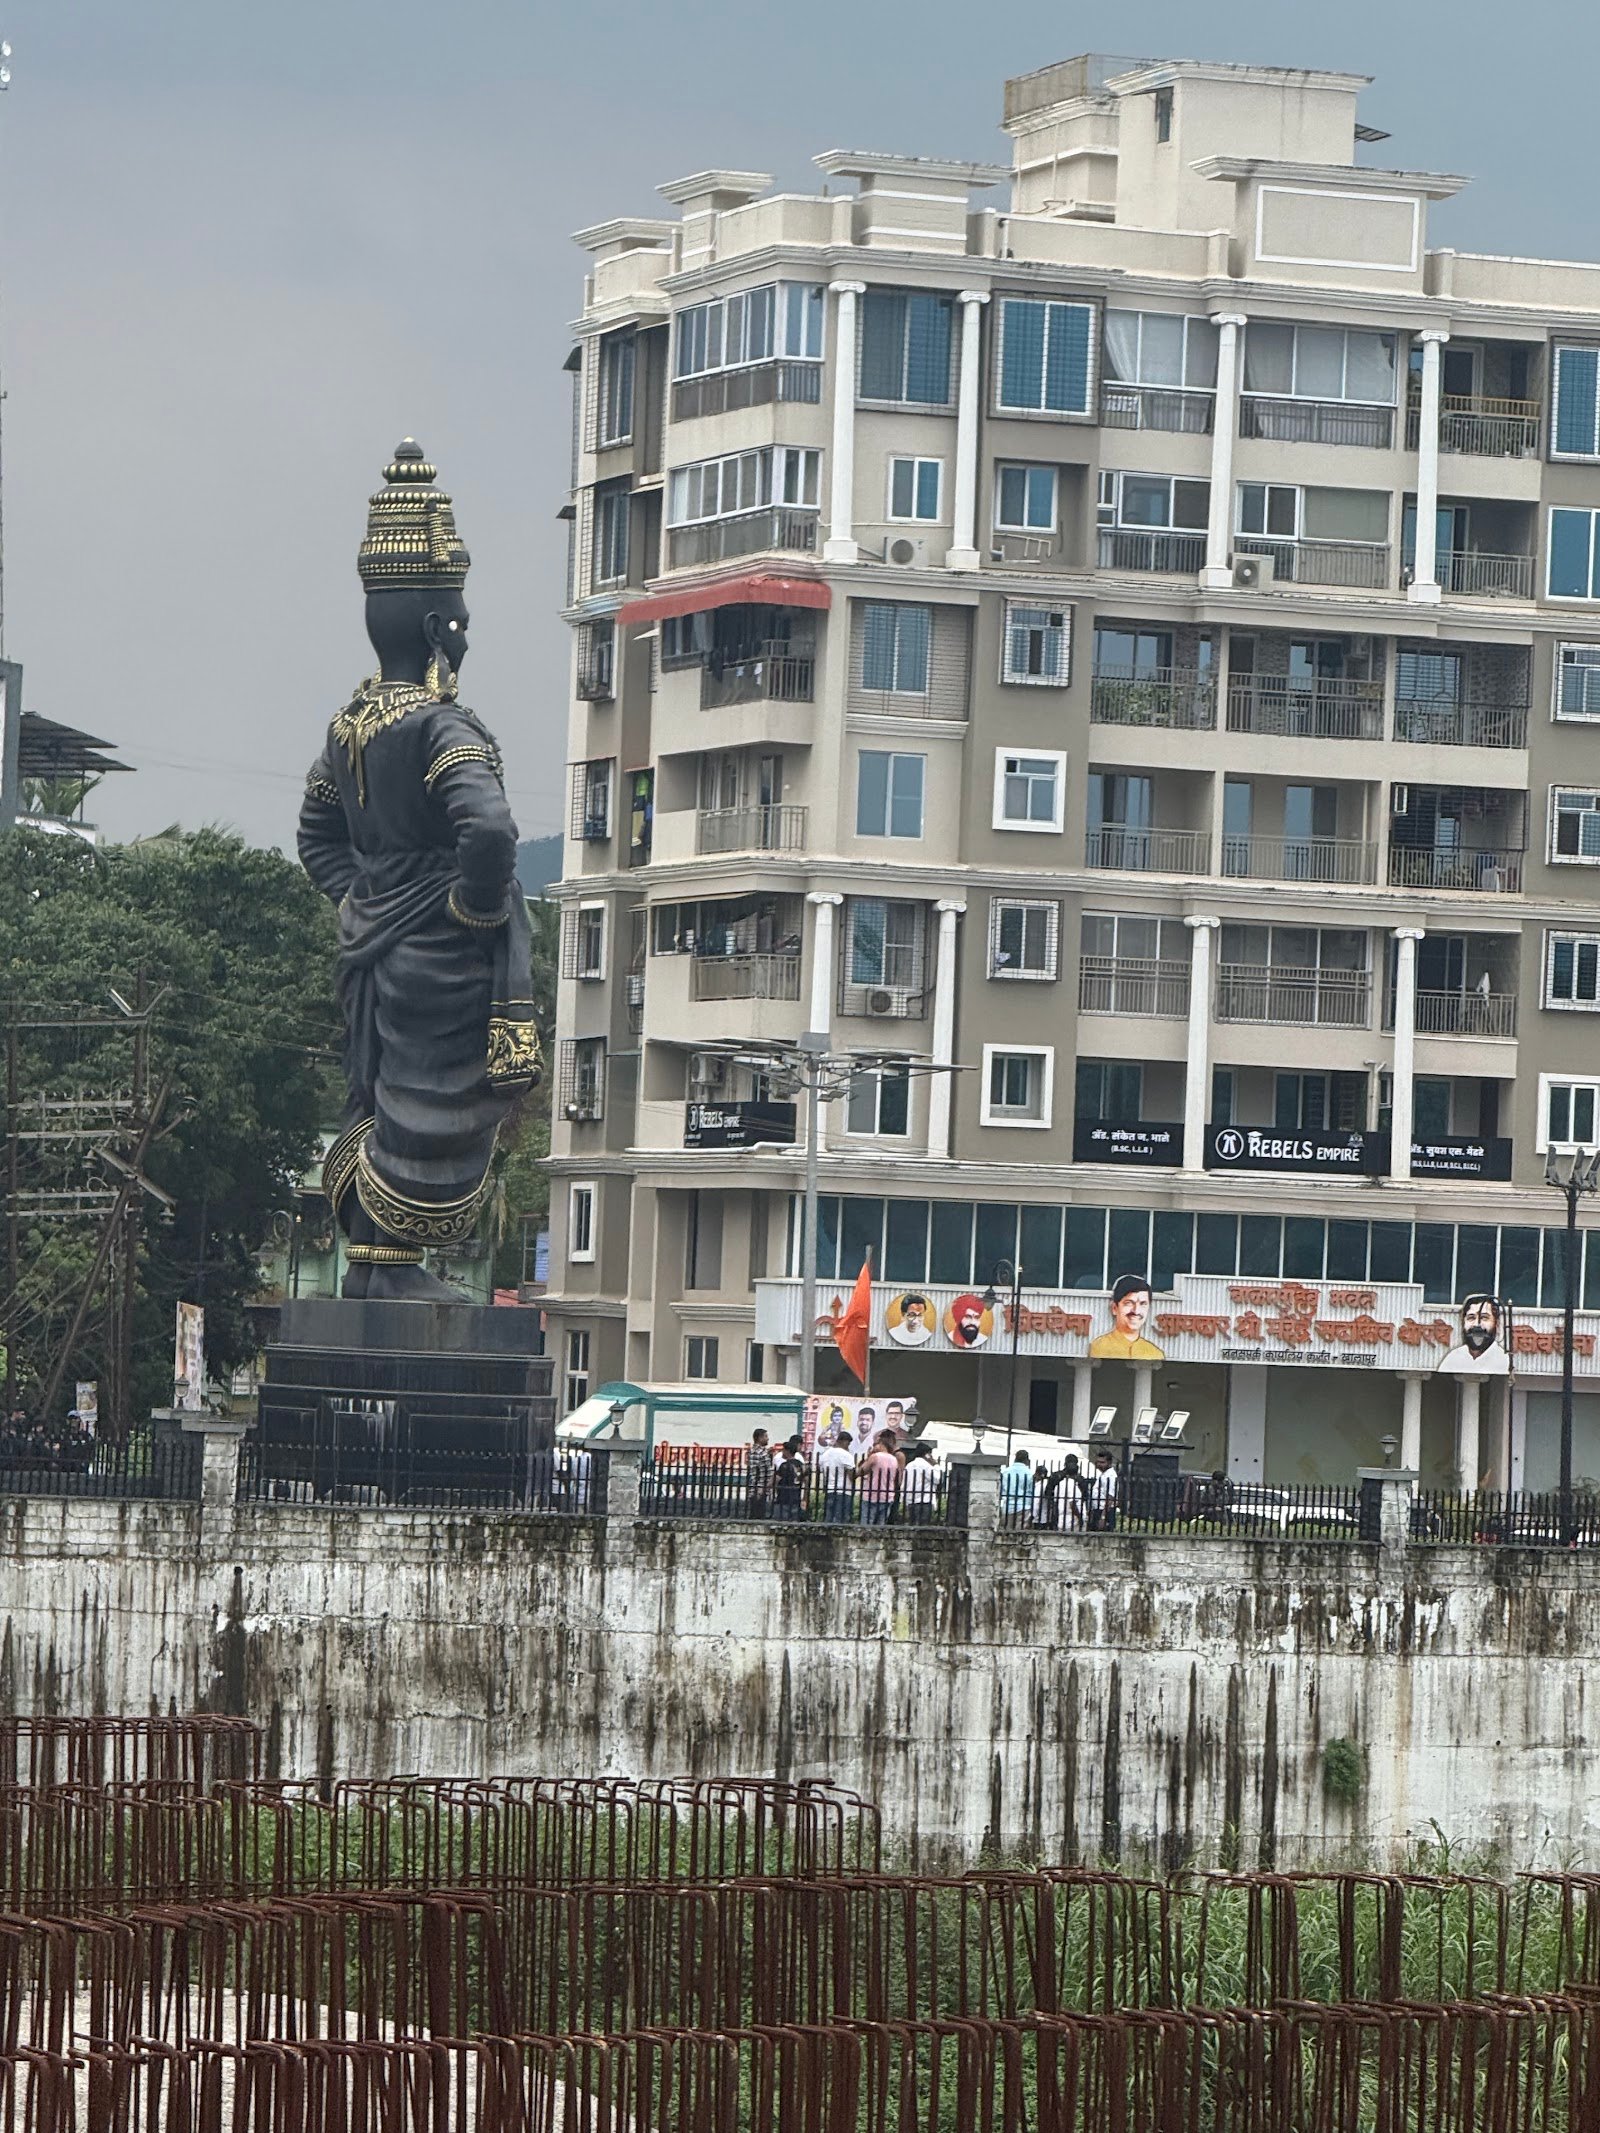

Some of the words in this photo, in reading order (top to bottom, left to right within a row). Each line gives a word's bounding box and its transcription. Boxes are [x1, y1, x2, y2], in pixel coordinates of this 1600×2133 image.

[1249, 1136, 1313, 1159] REBELS
[1316, 1147, 1360, 1162] EMPIRE
[1329, 1290, 1377, 1309] भवन
[1234, 1311, 1266, 1342] श्री
[1265, 1348, 1303, 1360] कार्यालय
[1306, 1350, 1331, 1361] कर्जत
